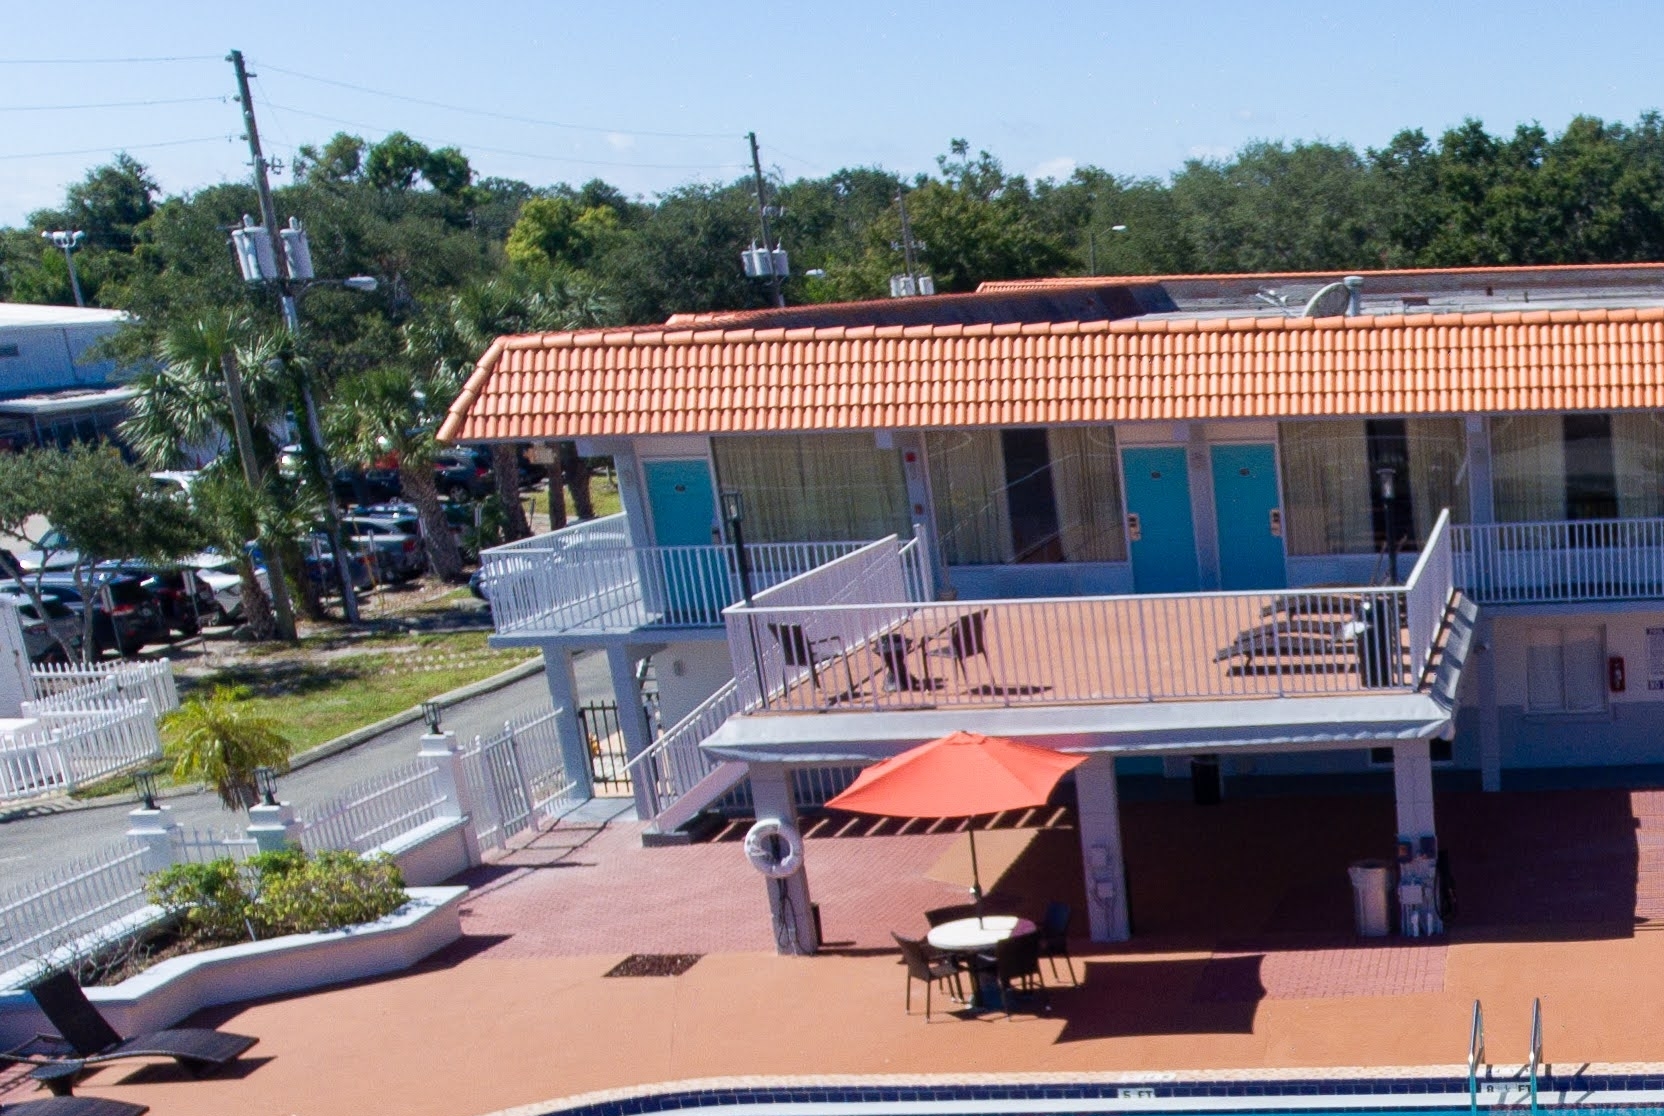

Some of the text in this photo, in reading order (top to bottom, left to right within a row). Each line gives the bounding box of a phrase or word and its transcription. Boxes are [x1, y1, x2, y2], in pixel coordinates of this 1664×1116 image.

[1650, 680, 1661, 689] NO
[1123, 1090, 1153, 1098] 5 FT
